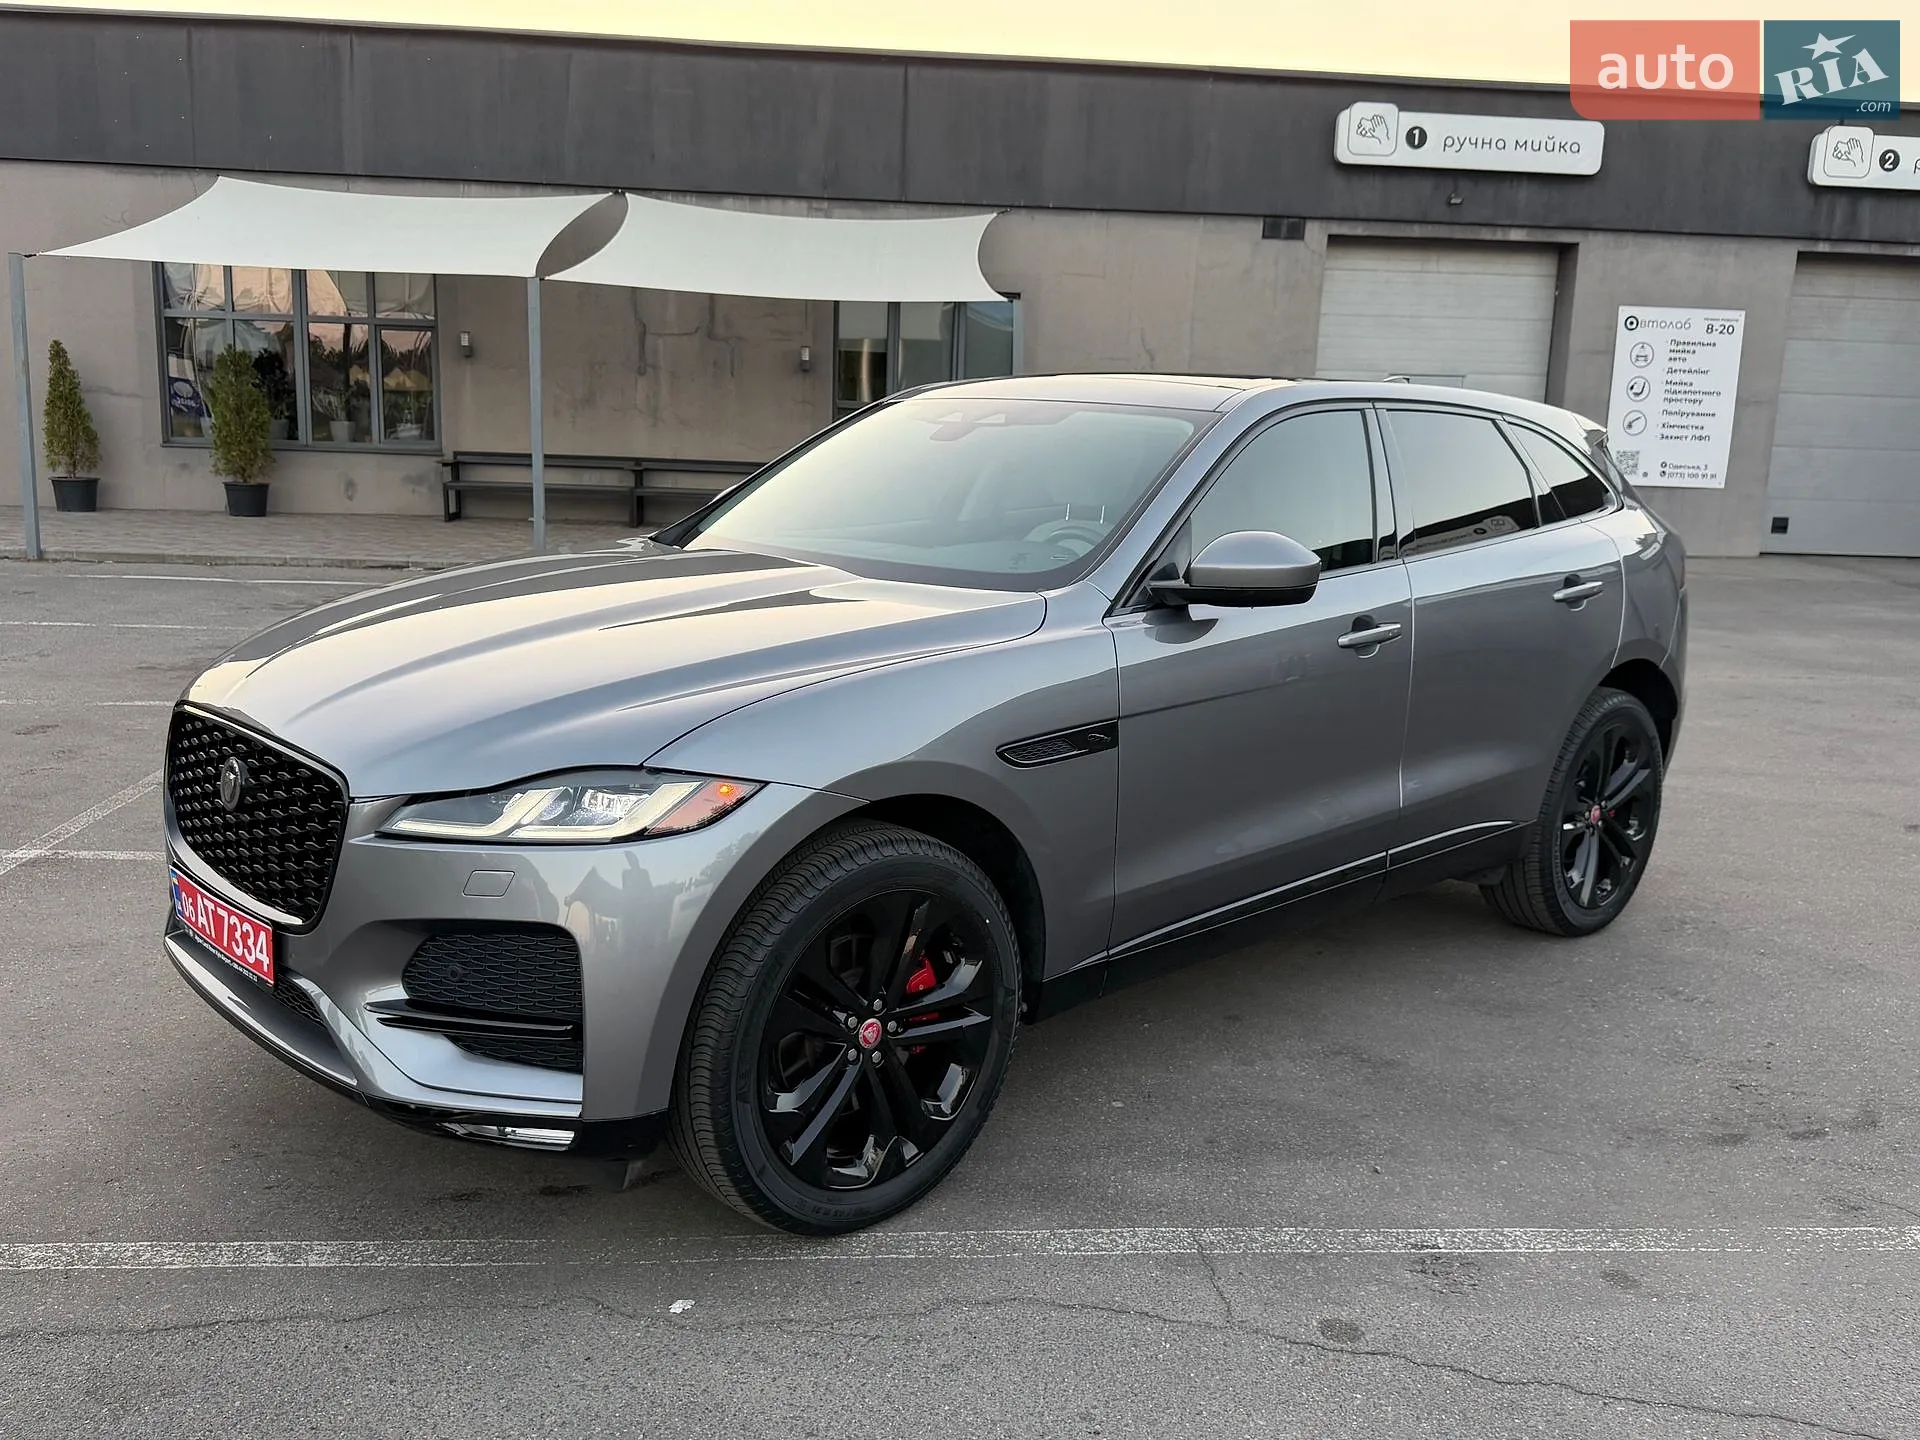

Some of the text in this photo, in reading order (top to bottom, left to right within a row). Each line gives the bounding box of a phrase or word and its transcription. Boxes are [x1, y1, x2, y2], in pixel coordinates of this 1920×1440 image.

[1442, 134, 1506, 152] ручна
[1515, 135, 1581, 154] мийка
[1705, 323, 1735, 335] 8-20
[1669, 338, 1717, 348] Правильна
[1666, 367, 1710, 375] Детейлінг
[1665, 379, 1694, 387] Мийка
[1664, 388, 1721, 397] підкапотного
[1663, 396, 1703, 405] простору
[1661, 409, 1716, 418] Полірування
[1660, 422, 1704, 431] Хімчистка
[1659, 433, 1711, 442] Захист ЛФП
[181, 891, 196, 923] 06
[197, 892, 216, 940] AT
[217, 908, 270, 972] 7334
